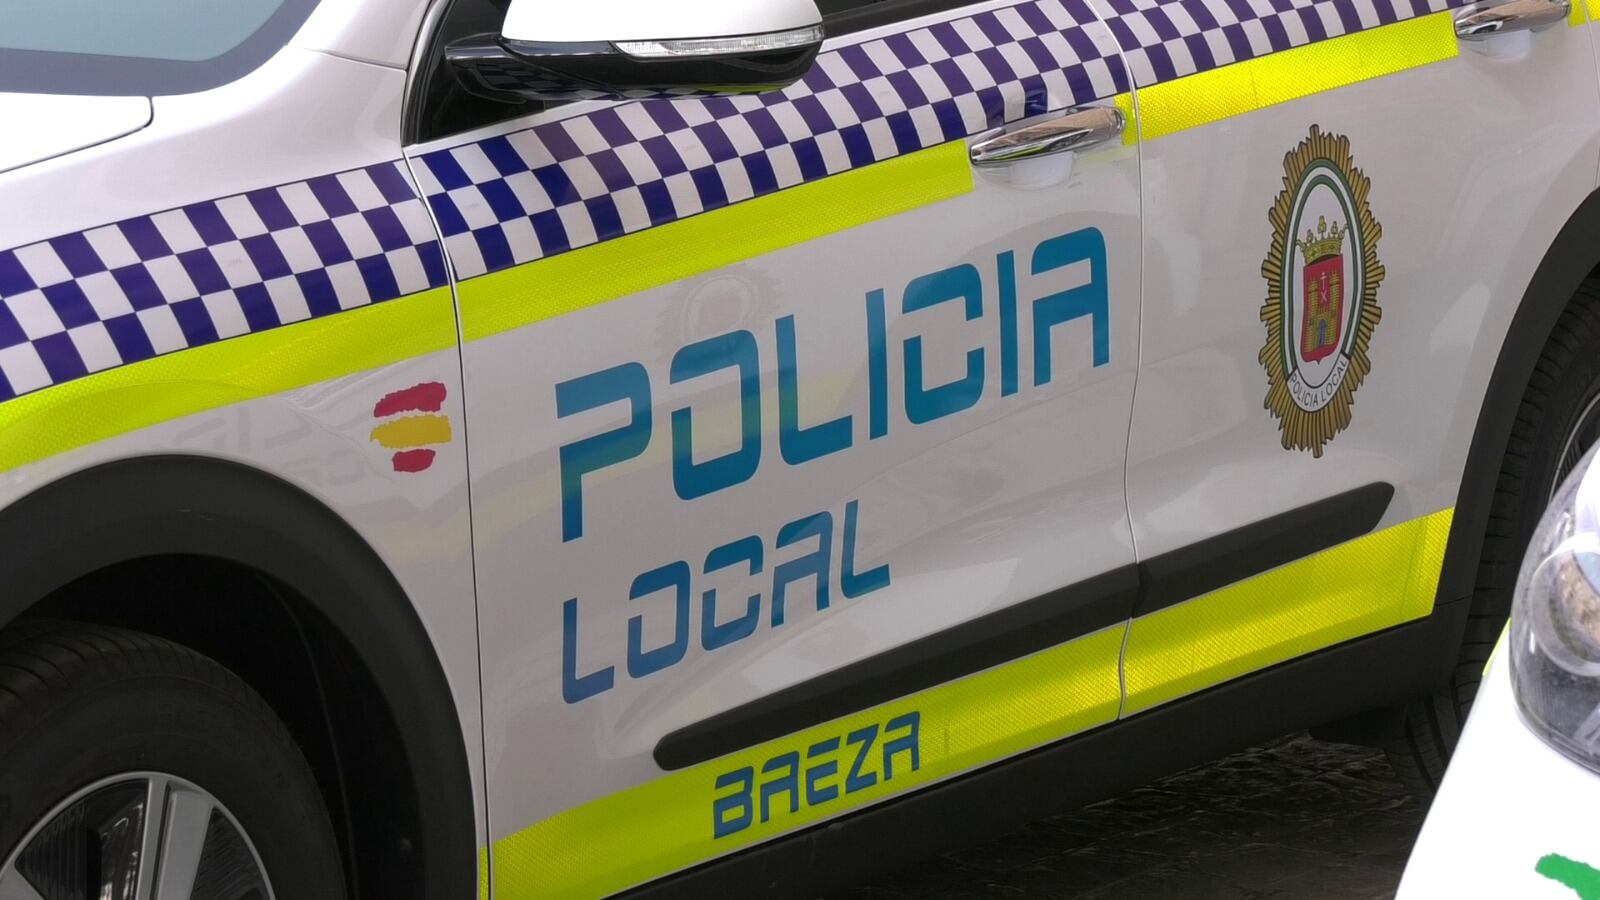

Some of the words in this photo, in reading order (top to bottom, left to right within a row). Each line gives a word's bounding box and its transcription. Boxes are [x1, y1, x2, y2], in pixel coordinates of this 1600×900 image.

[556, 227, 1109, 542] POLICIA
[1289, 373, 1318, 408] POLICIA
[1320, 360, 1347, 402] LOCAL
[563, 500, 890, 703] LOCAL
[713, 711, 920, 840] BAEZA
